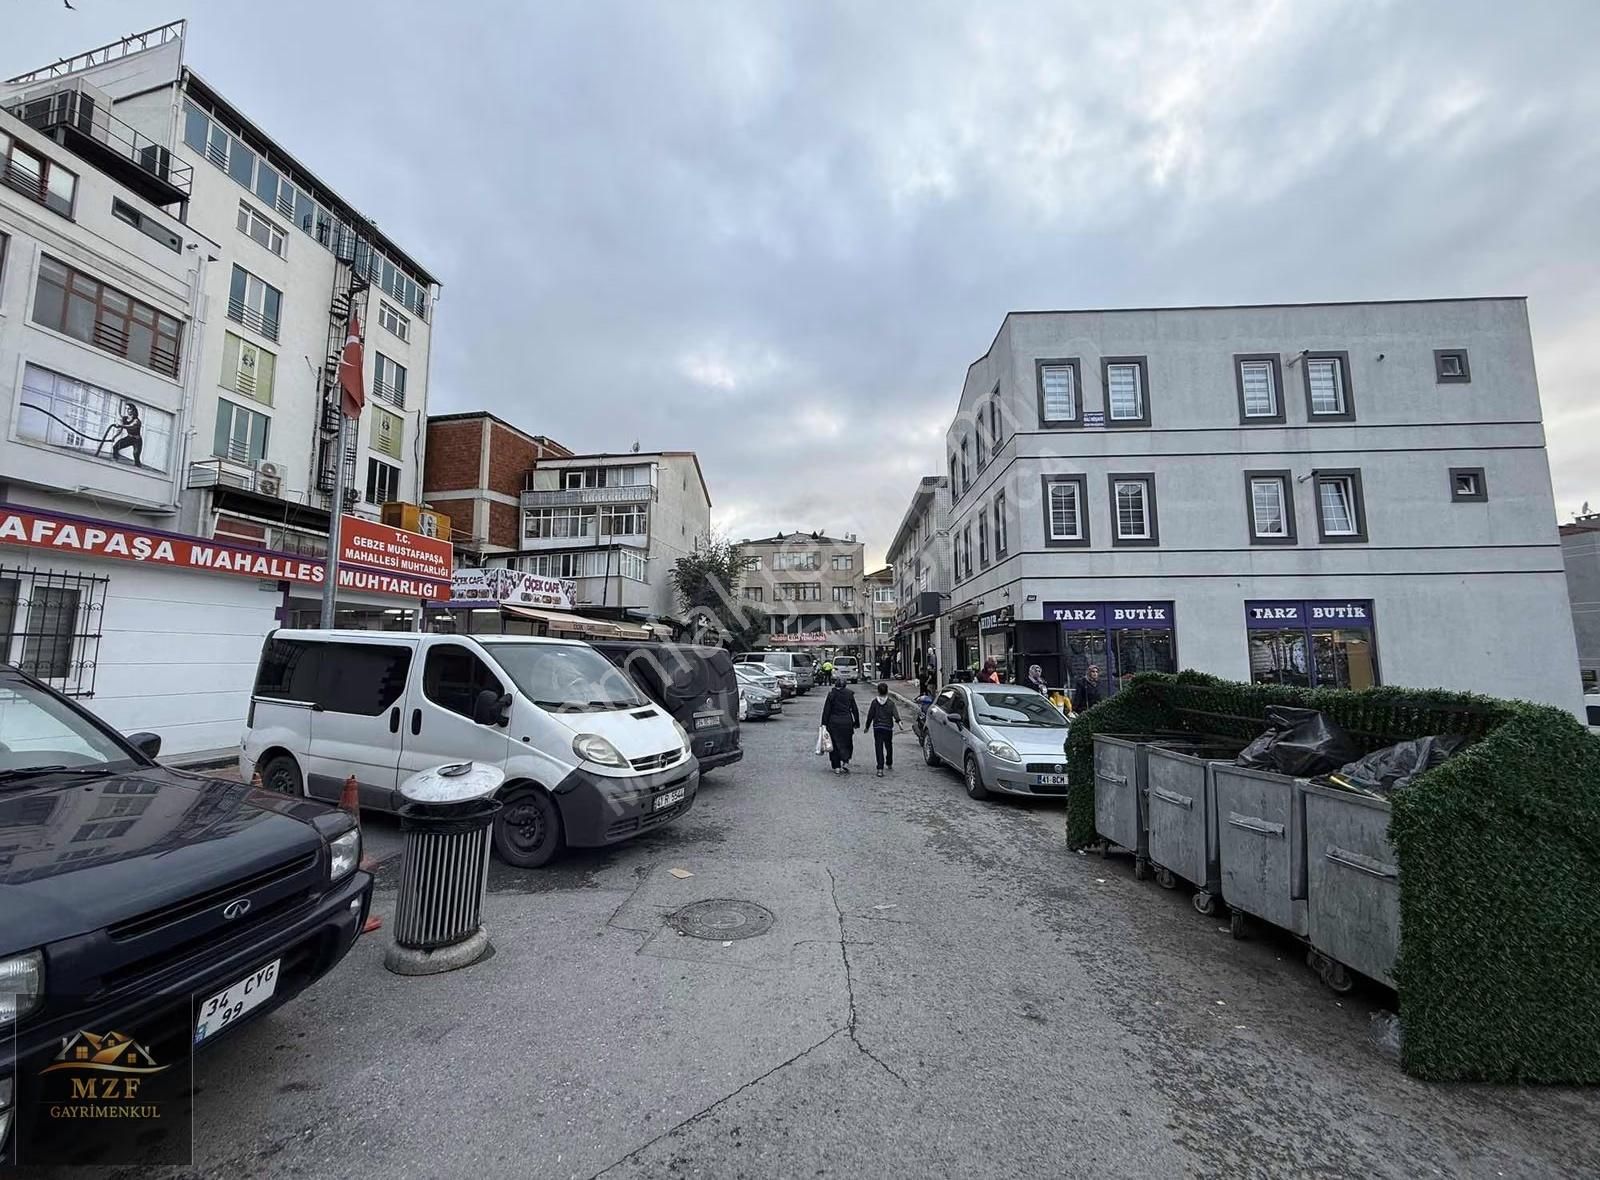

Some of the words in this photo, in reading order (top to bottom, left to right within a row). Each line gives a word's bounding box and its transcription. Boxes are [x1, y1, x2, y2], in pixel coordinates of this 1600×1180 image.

[353, 536, 385, 551] GEBZE
[387, 543, 444, 565] MUSTAFAPAŞA
[395, 532, 411, 544] T.C.
[0, 515, 175, 561] AFAPAŞA
[189, 545, 327, 583] MAHALLES
[339, 570, 438, 598] MUHTARLIĞI
[345, 548, 399, 567] MAHALLESİ
[400, 559, 448, 577] MUHTARLIĞI
[544, 581, 560, 594] CAFE
[1053, 609, 1096, 620] TARZ
[1114, 605, 1165, 620] BUTİK
[1253, 607, 1298, 619] TARZ
[1312, 604, 1366, 618] BUTİK
[207, 992, 229, 1017] 34
[244, 964, 275, 995] CYG
[220, 1001, 243, 1026] 99
